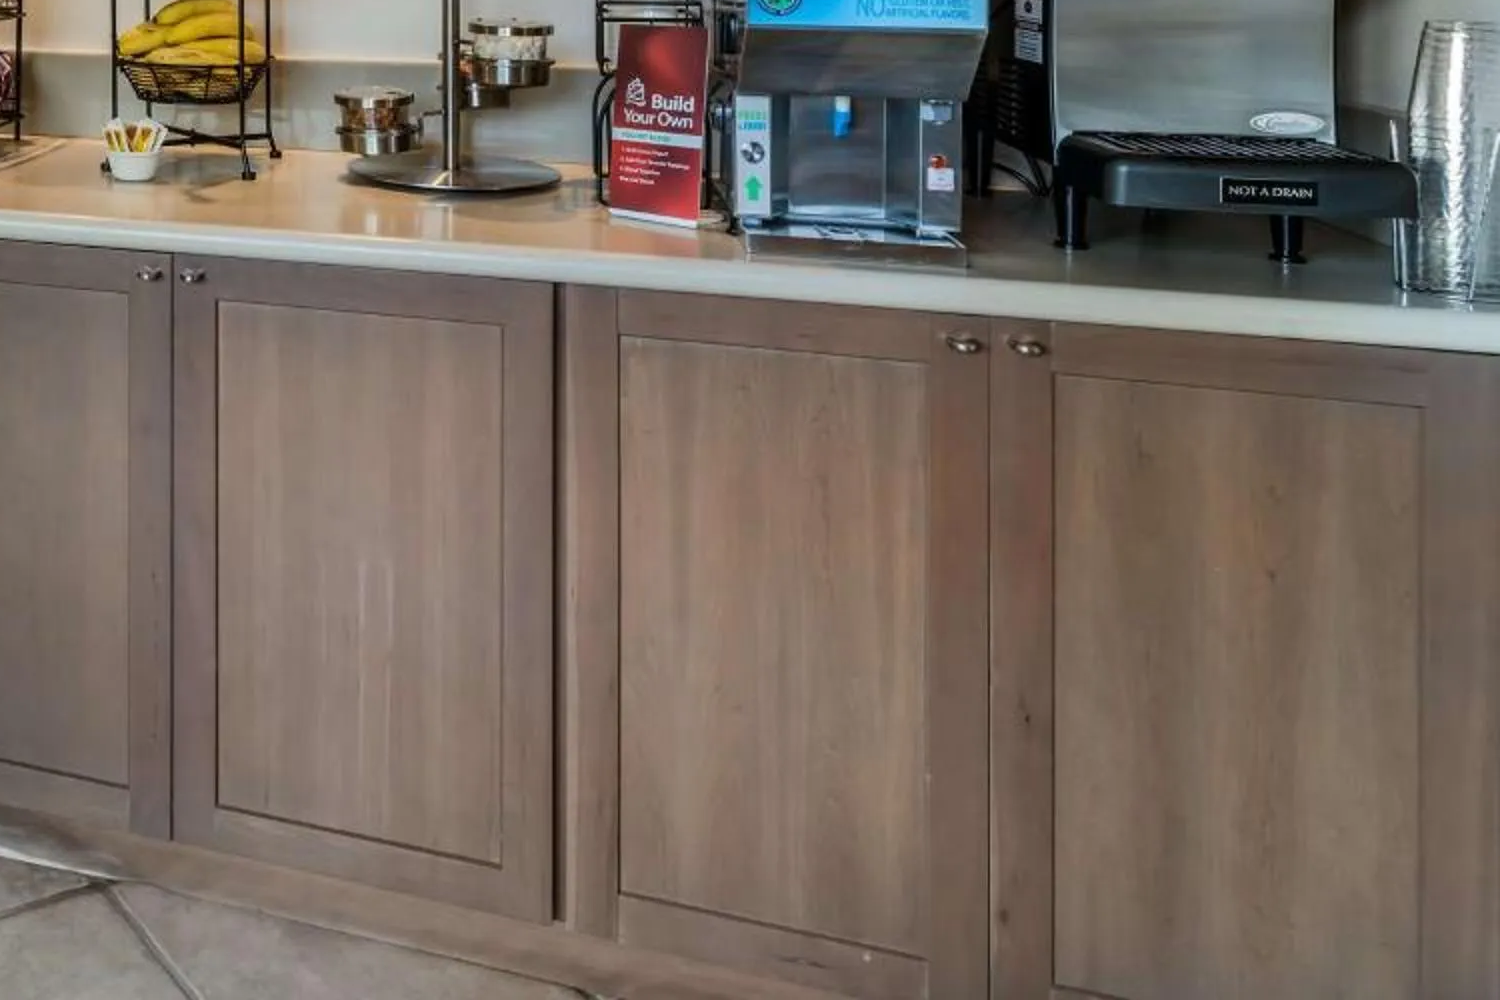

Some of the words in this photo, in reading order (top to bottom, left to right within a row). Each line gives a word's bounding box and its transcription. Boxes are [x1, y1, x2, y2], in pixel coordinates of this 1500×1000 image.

[651, 93, 695, 113] Build
[623, 107, 656, 124] Your
[657, 111, 693, 129] Own
[1228, 185, 1258, 197] NOT
[1259, 186, 1270, 197] A
[1271, 187, 1313, 199] DRAIN
